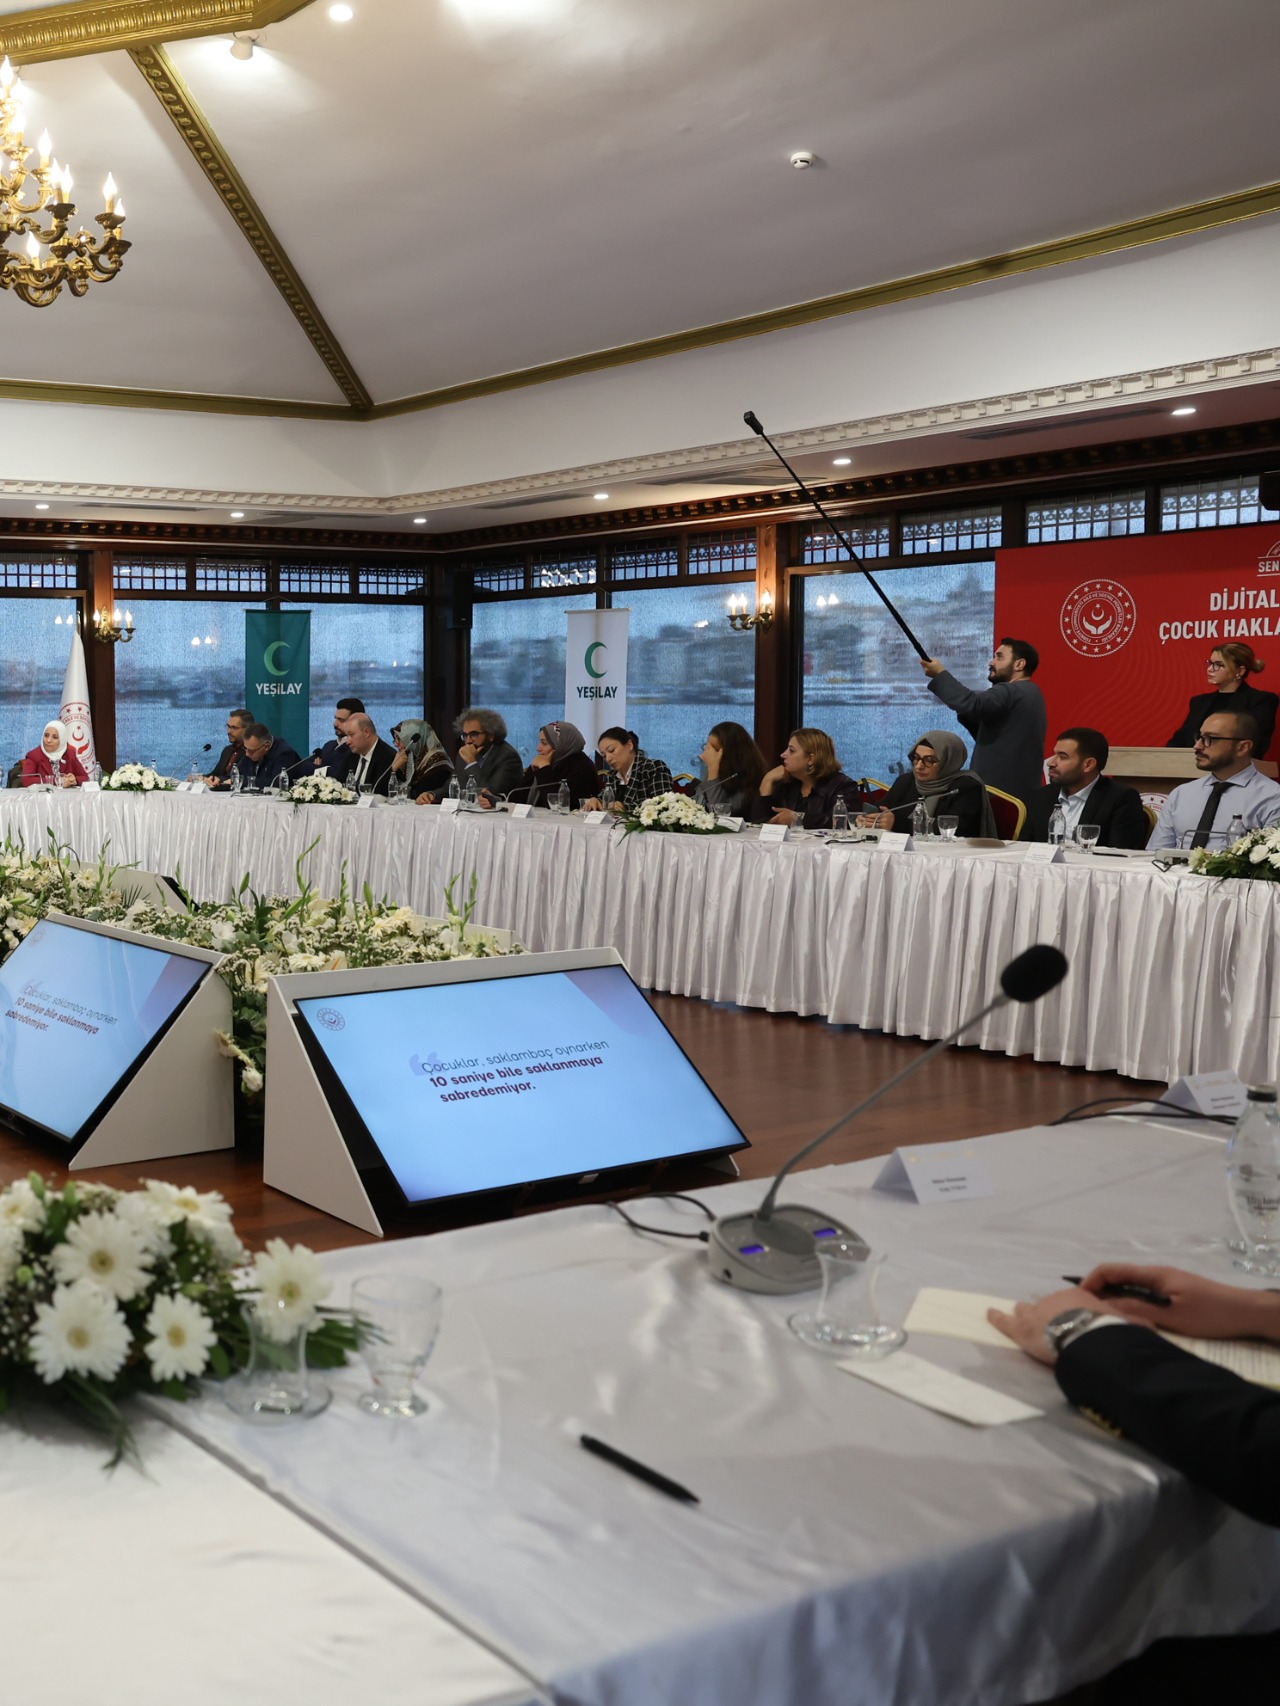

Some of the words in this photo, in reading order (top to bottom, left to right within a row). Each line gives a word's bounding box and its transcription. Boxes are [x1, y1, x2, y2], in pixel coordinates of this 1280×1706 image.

[1210, 587, 1280, 611] DİJİTAL
[1159, 620, 1218, 645] ÇOCUK
[256, 683, 302, 697] YEŞİLAY
[576, 686, 618, 700] YEŞİLAY
[486, 1048, 553, 1065] saklambaç
[555, 1039, 609, 1055] oynarken
[430, 1076, 447, 1087] 10
[451, 1071, 495, 1085] saniye
[496, 1068, 522, 1079] bile
[525, 1056, 603, 1074] saklanmaya
[440, 1080, 536, 1102] sabredemiyor.
